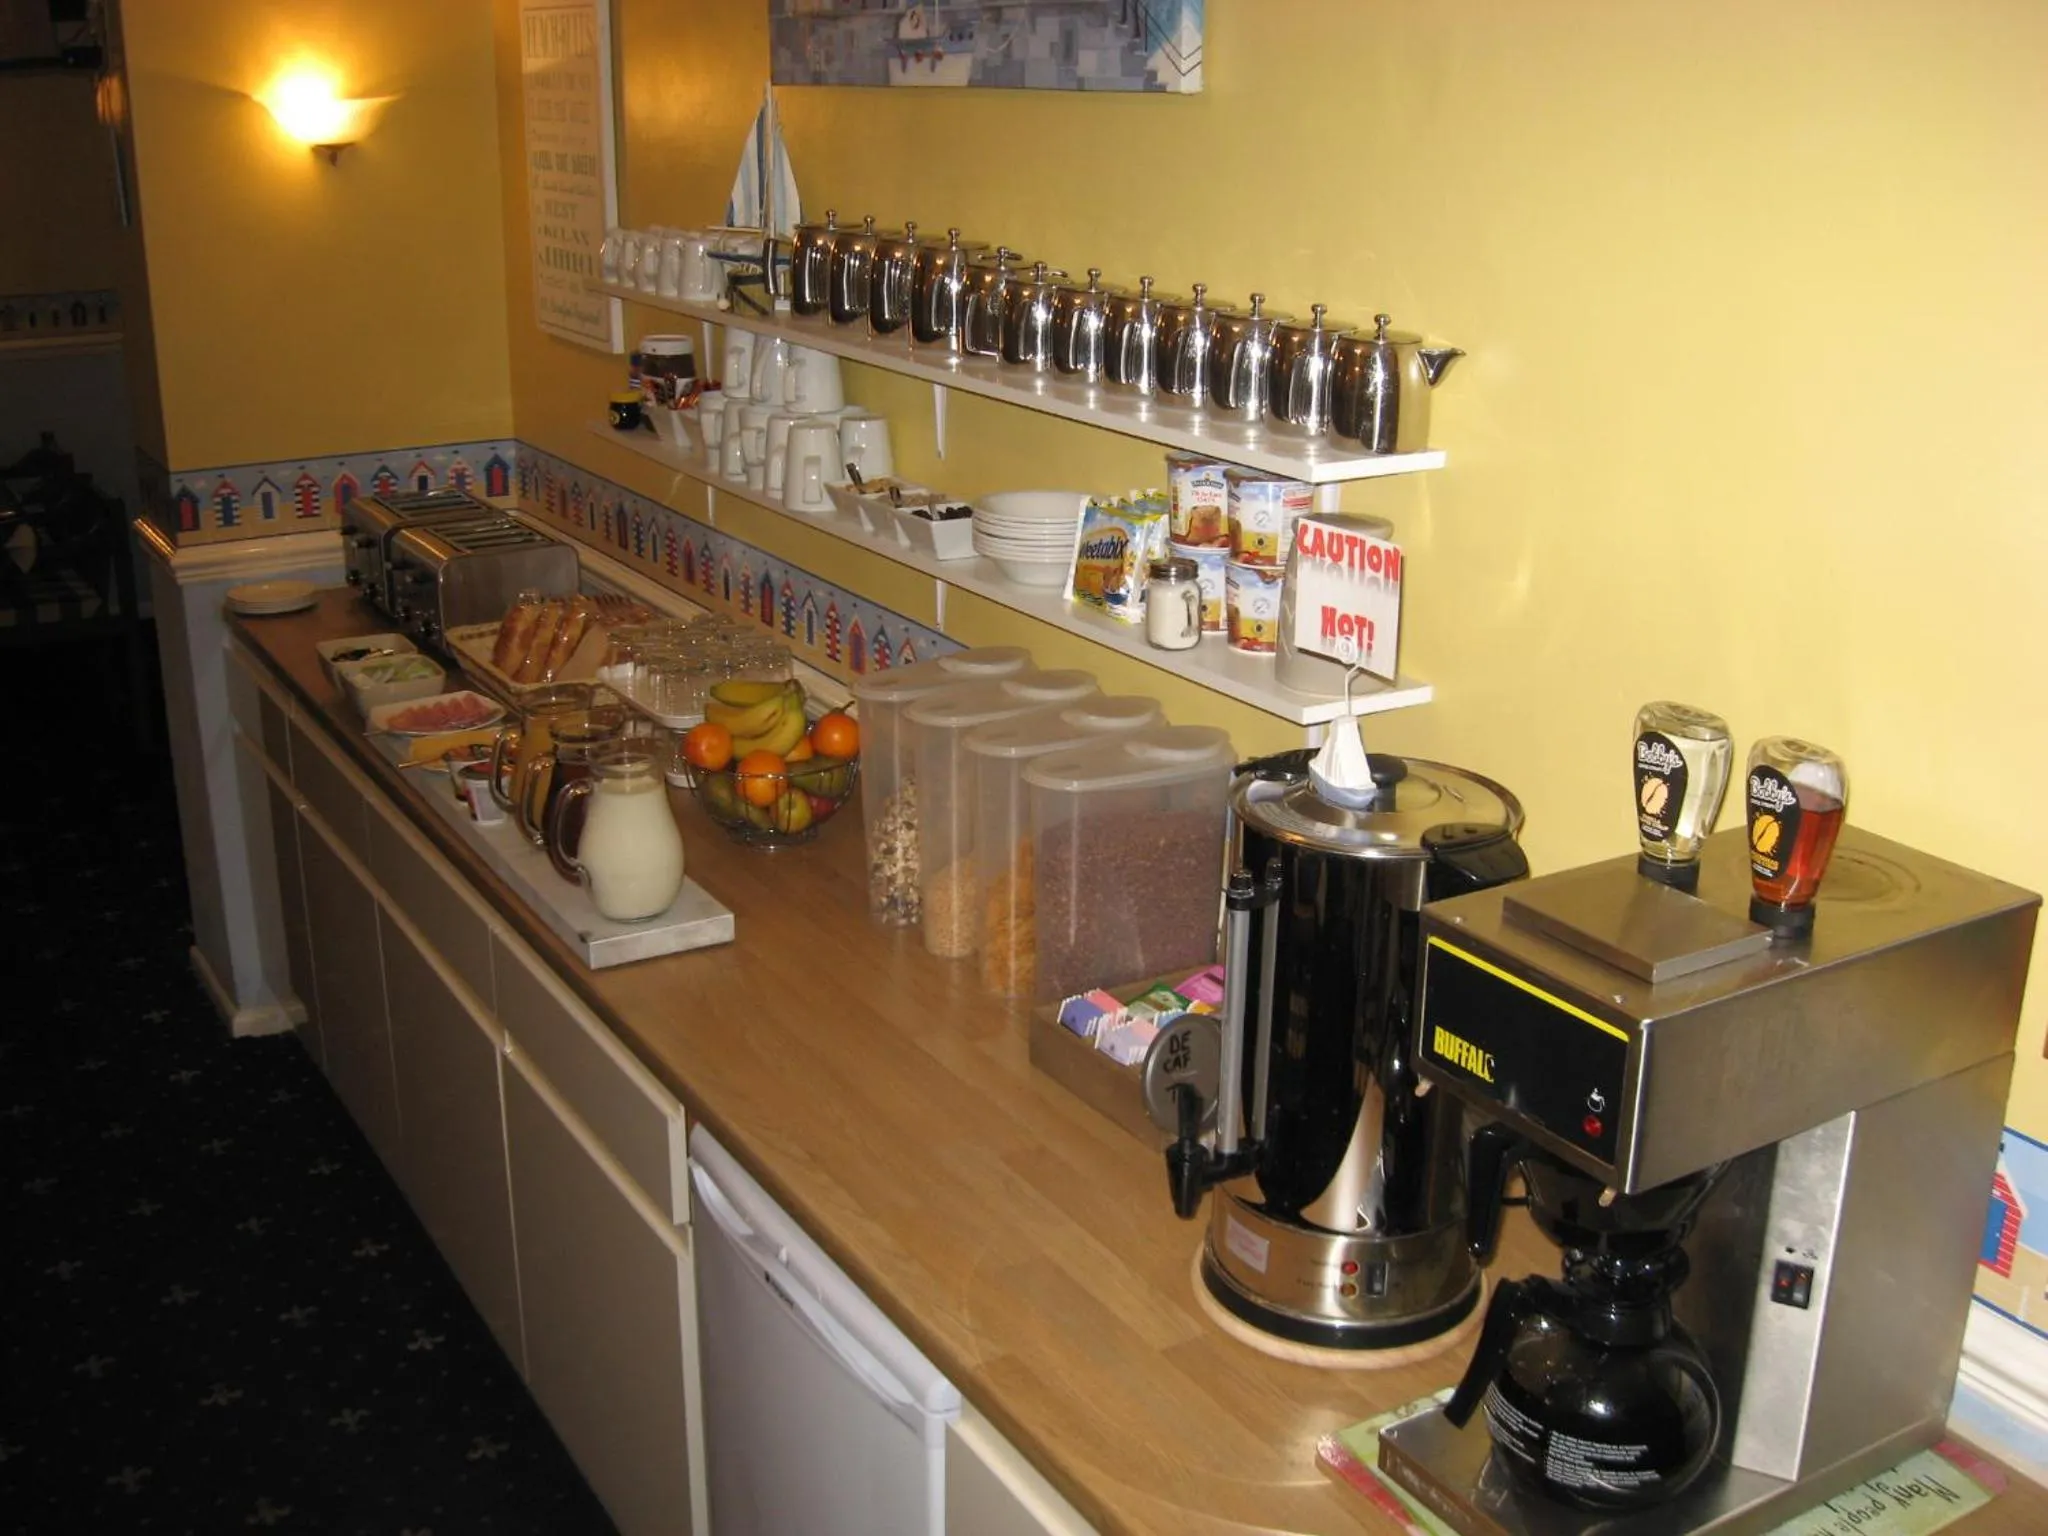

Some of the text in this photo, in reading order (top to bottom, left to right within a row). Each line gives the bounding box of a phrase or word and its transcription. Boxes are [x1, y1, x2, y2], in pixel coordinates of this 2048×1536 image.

[1297, 522, 1401, 581] CAUTION
[1321, 605, 1375, 651] HOT!
[1169, 1030, 1192, 1055] DE
